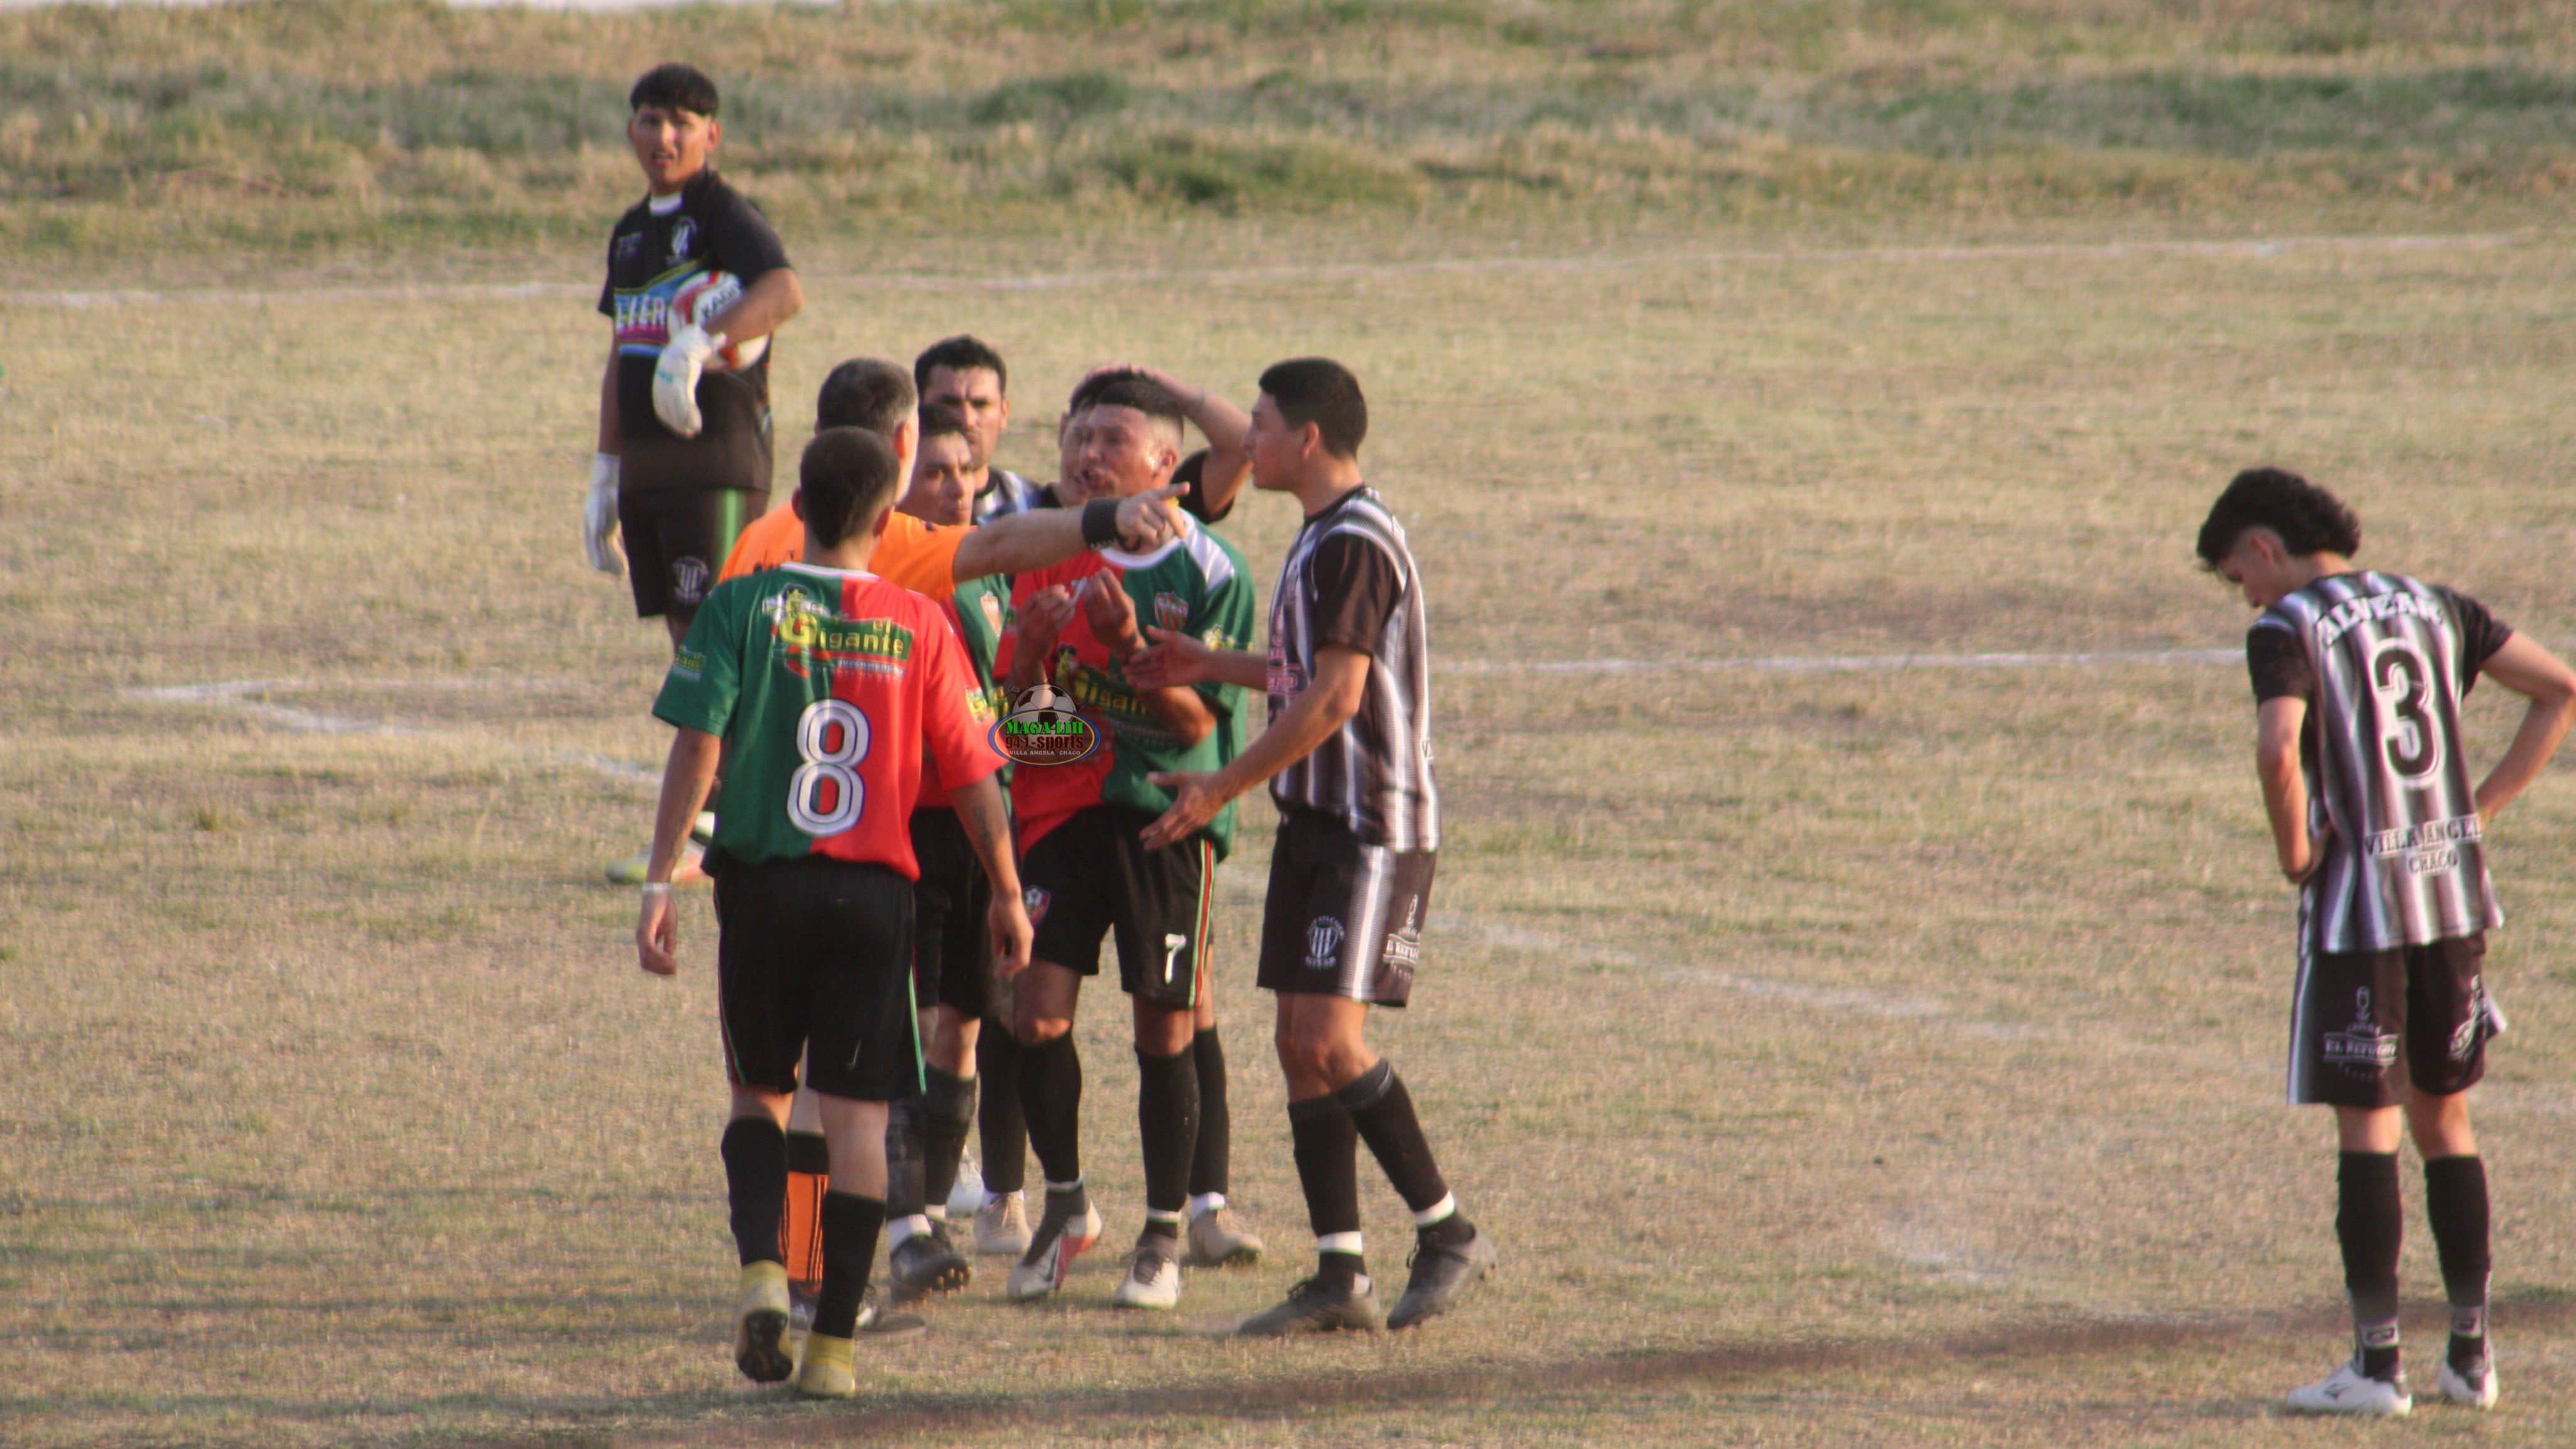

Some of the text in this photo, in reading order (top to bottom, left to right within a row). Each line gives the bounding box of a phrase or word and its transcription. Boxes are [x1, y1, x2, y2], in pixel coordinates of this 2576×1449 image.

[779, 611, 904, 654] Gigante
[873, 619, 892, 635] el
[2315, 591, 2444, 645] ALVEAR
[2373, 638, 2444, 789] 3
[787, 699, 871, 838] 8
[2365, 816, 2481, 855] VILLA ANGEL
[2408, 849, 2458, 873] CHACO
[1165, 934, 1187, 983] 7
